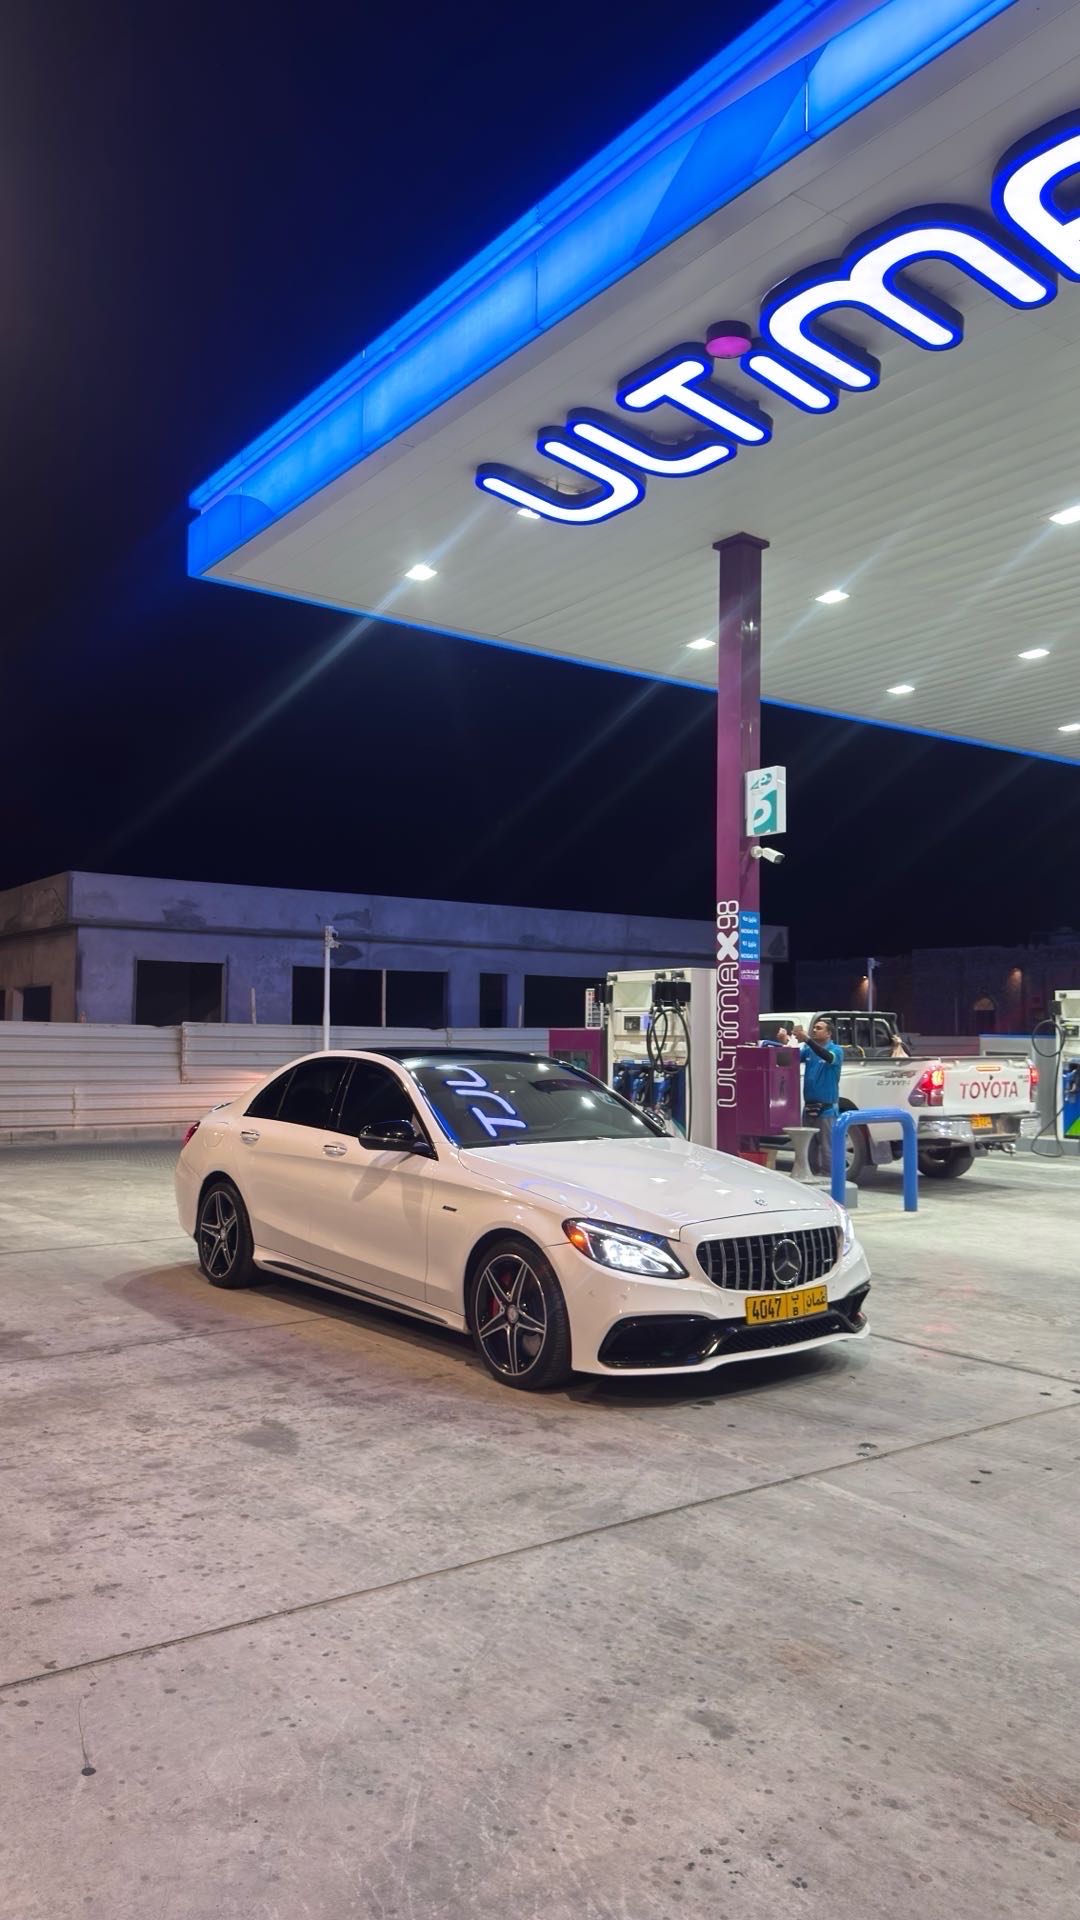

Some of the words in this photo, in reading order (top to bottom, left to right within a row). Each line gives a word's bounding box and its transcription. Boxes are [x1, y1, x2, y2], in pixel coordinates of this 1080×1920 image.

[960, 1081, 1018, 1099] TOYOTA
[752, 1297, 782, 1320] 4047
[792, 1306, 799, 1316] B
